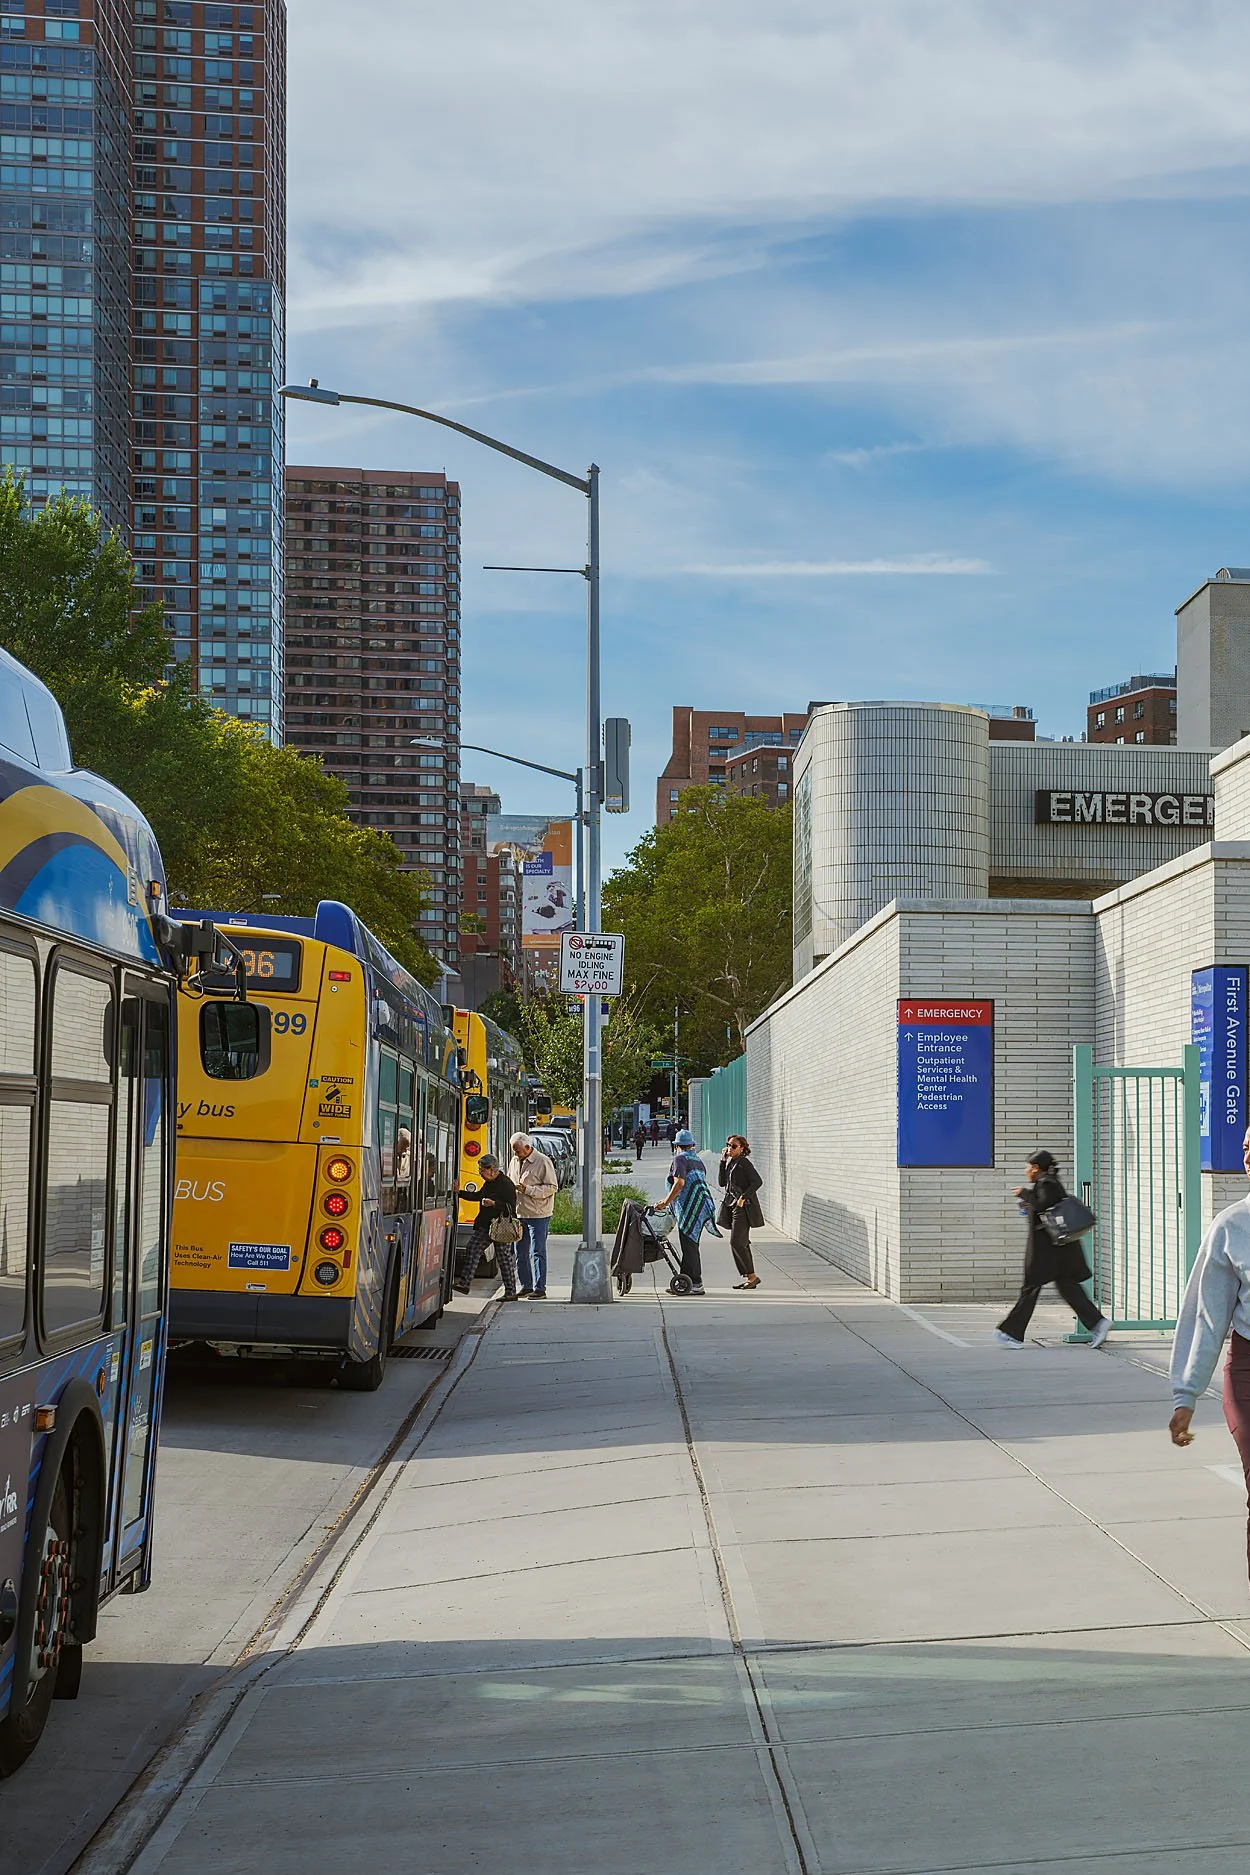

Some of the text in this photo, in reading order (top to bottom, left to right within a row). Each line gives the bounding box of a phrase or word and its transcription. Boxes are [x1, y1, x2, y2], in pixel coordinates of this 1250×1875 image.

[569, 951, 614, 961] NO ENGINE
[578, 961, 605, 970] IDLING
[567, 969, 614, 980] MAX FINE
[568, 1004, 581, 1012] M96
[917, 1008, 983, 1019] EMERGENCY
[270, 1011, 307, 1036] 99
[917, 1032, 968, 1044] Employee
[917, 1043, 962, 1052] Entrance
[1226, 977, 1241, 1125] First Avenue Gate
[917, 1056, 965, 1066] Outpatient
[917, 1066, 953, 1074] Services
[322, 1076, 353, 1084] CAUTION
[917, 1075, 978, 1083] Mental Health
[917, 1083, 947, 1092] Center
[917, 1092, 963, 1101] Pedestrian
[196, 1100, 235, 1118] bus
[320, 1104, 350, 1114] WIDE
[917, 1102, 948, 1110] Access
[174, 1179, 226, 1202] BUS
[231, 1245, 258, 1253] SAFETY'S
[266, 1253, 287, 1261] Doing?
[174, 1259, 211, 1269] Technology
